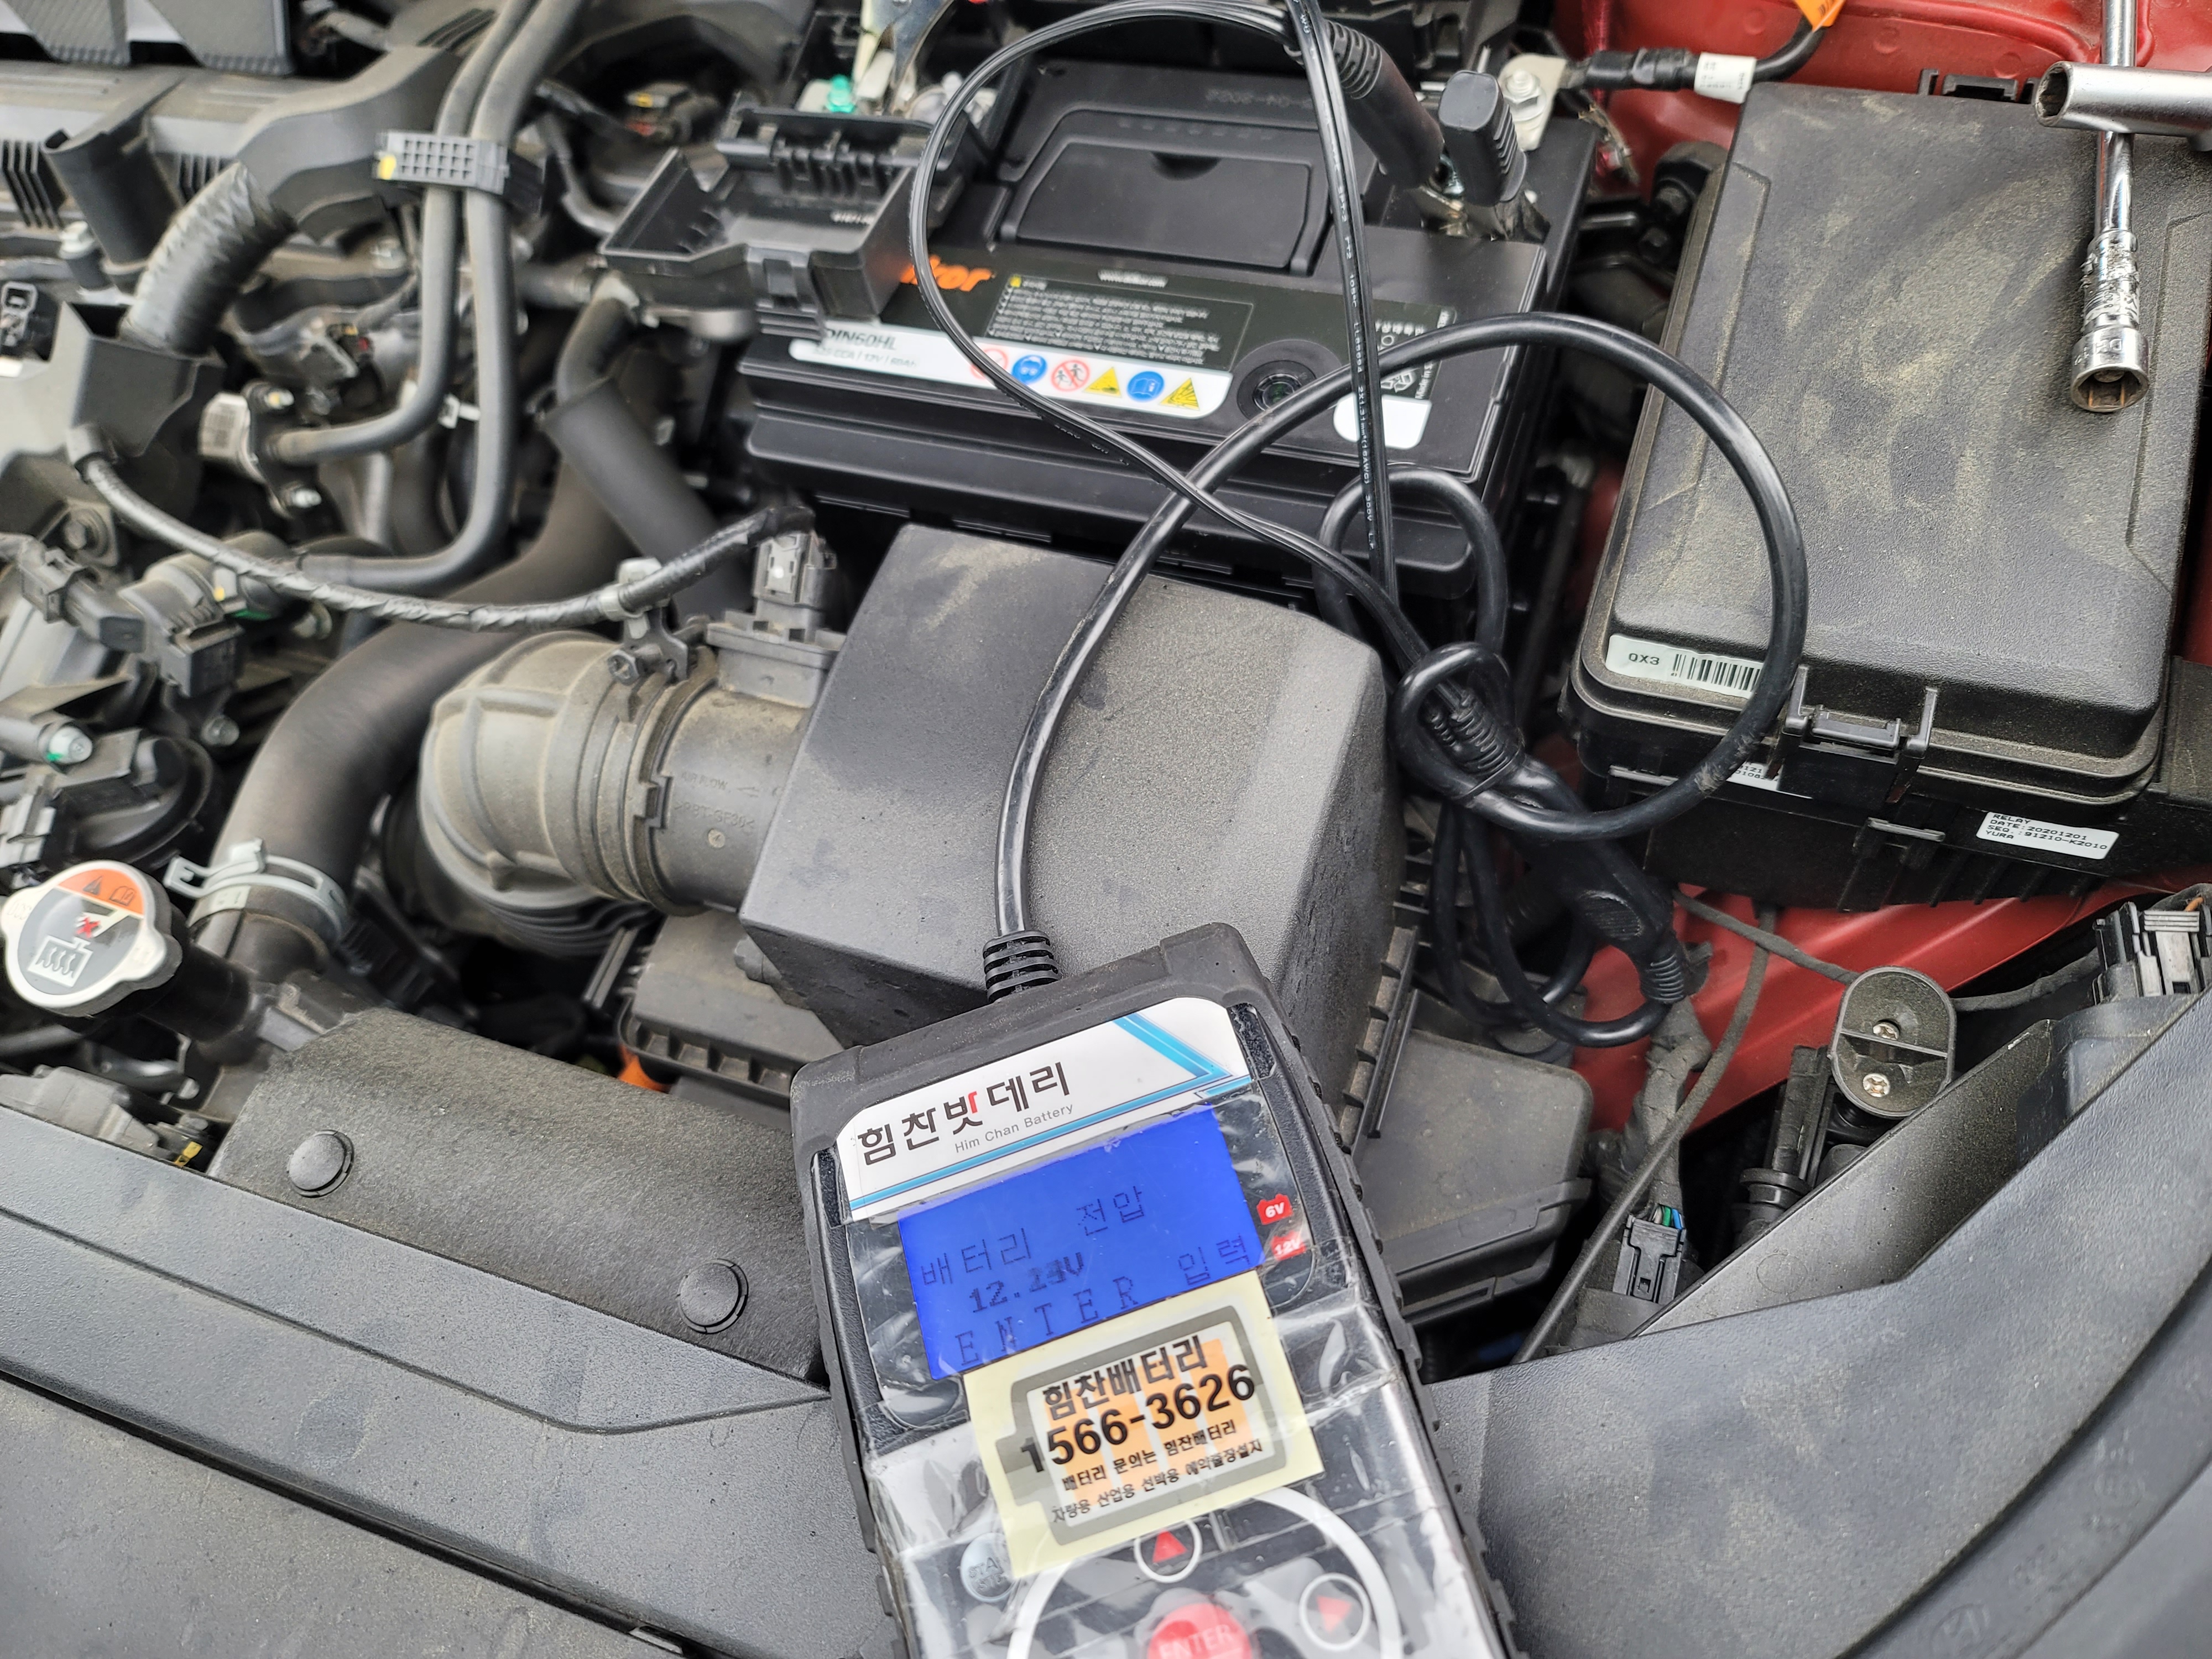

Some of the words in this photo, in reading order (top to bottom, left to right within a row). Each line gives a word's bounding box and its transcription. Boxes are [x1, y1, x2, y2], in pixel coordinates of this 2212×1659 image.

[1985, 830, 2014, 839] YURA
[1993, 814, 2031, 825] RELAY
[954, 1138, 980, 1153] Him
[984, 1123, 1020, 1142] Chan
[1023, 1104, 1074, 1128] Battery
[1265, 1202, 1285, 1218] 6V
[920, 1227, 1031, 1286] 배터리
[1076, 1185, 1145, 1237] 전압
[1274, 1239, 1302, 1255] 12V
[1178, 1233, 1250, 1286] 입력
[1042, 1335, 1208, 1421] 힘찬배터리
[1020, 1364, 1255, 1473] 1566-3626
[1062, 1464, 1107, 1491] 배터리
[1113, 1449, 1157, 1474] 문의는
[1051, 1499, 1091, 1523] 차량용
[1097, 1484, 1136, 1507] 산업용
[1141, 1468, 1180, 1492] 선박용
[1160, 1624, 1237, 1659] ENTER
